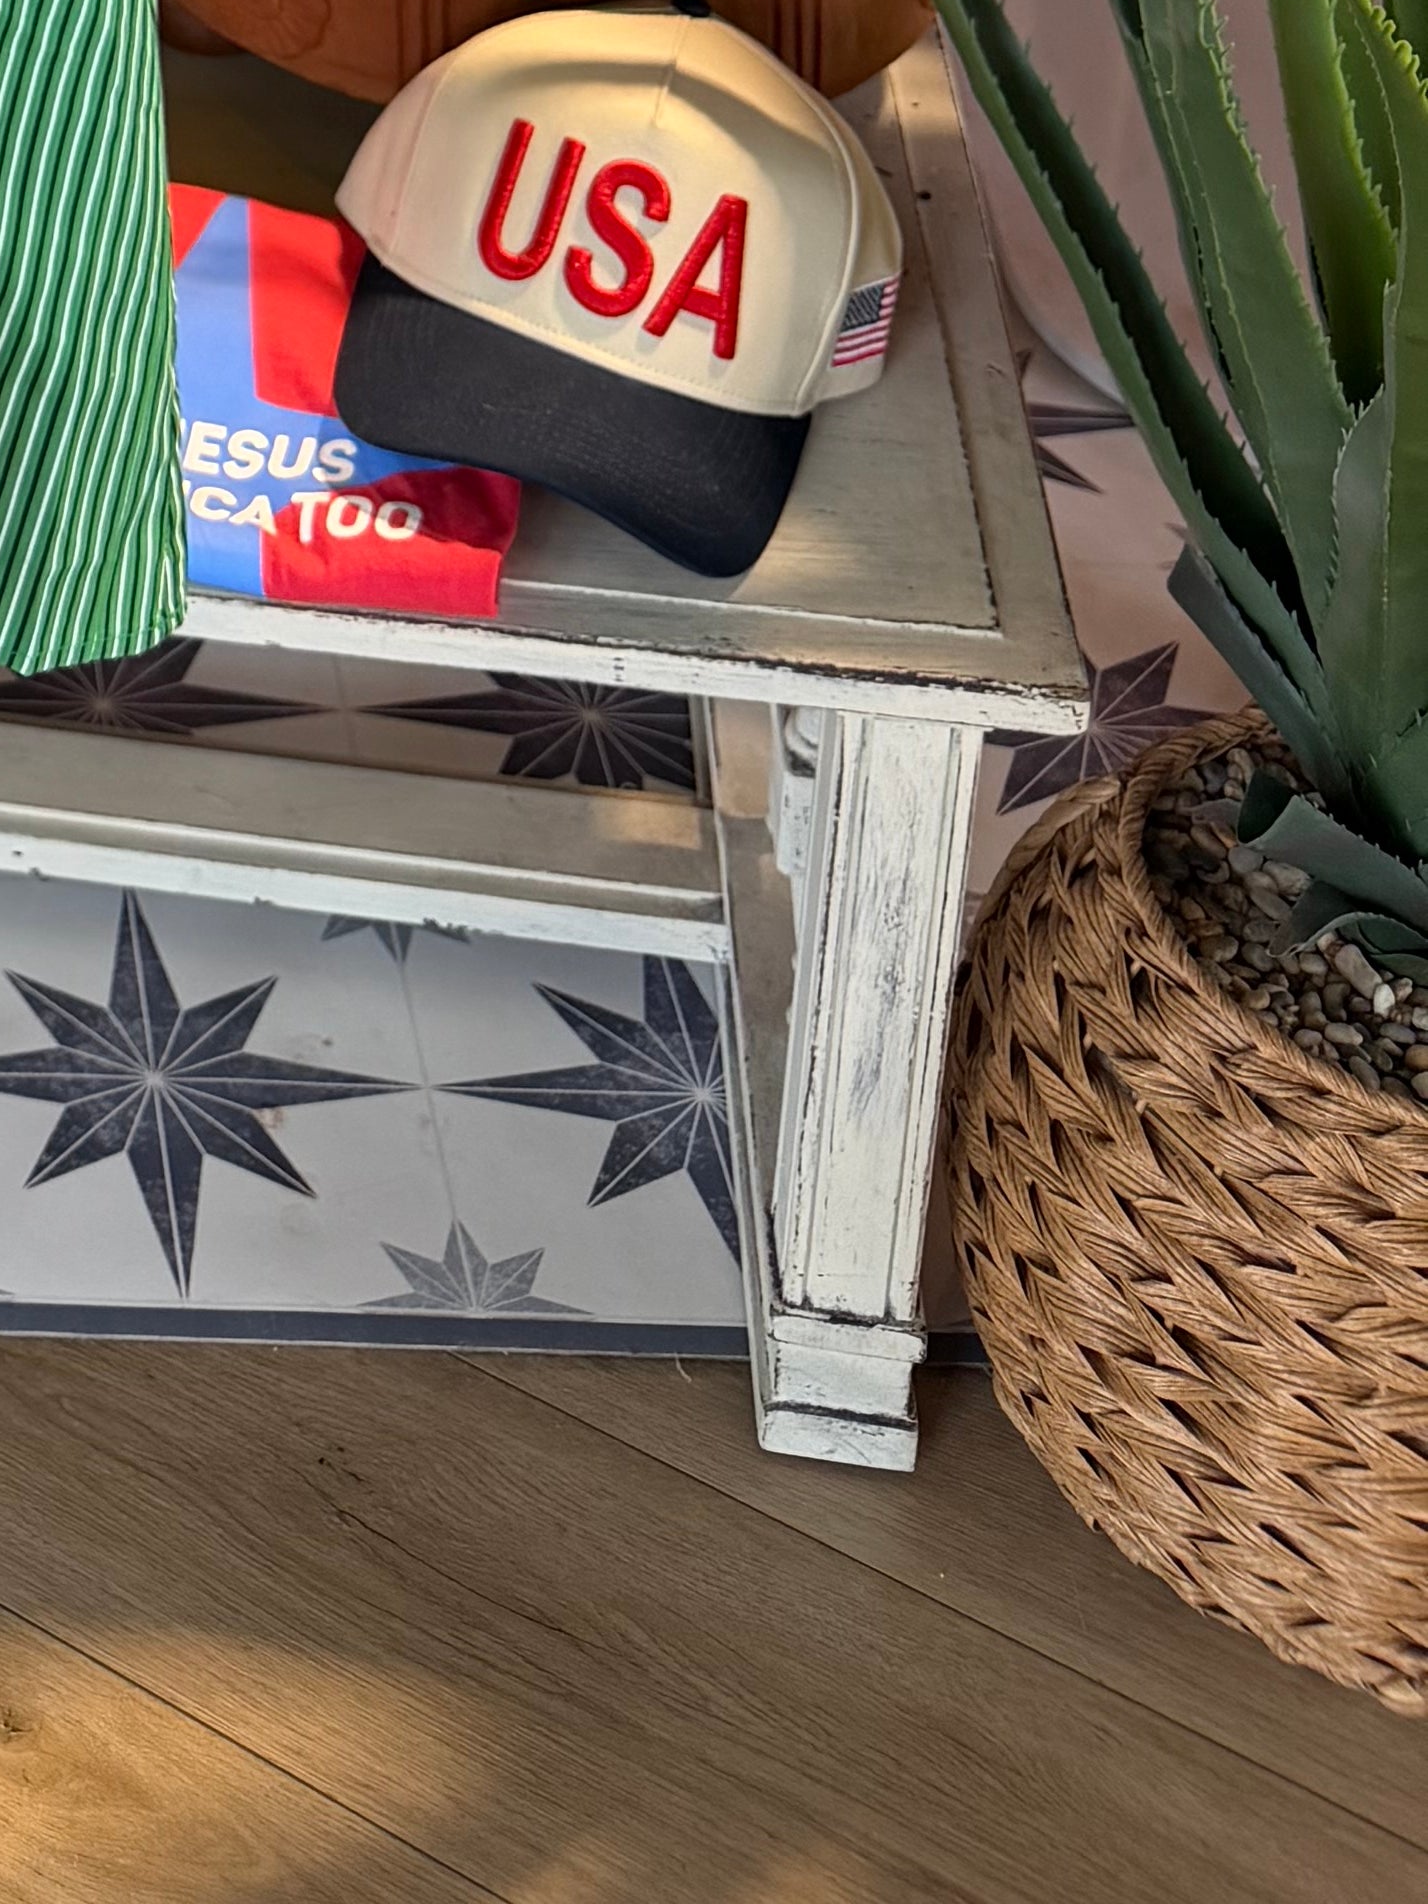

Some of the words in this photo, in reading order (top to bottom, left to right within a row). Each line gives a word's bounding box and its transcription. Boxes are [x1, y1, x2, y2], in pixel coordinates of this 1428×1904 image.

[476, 117, 749, 361] USA
[179, 417, 358, 484] ESUS
[290, 490, 424, 545] TOO
